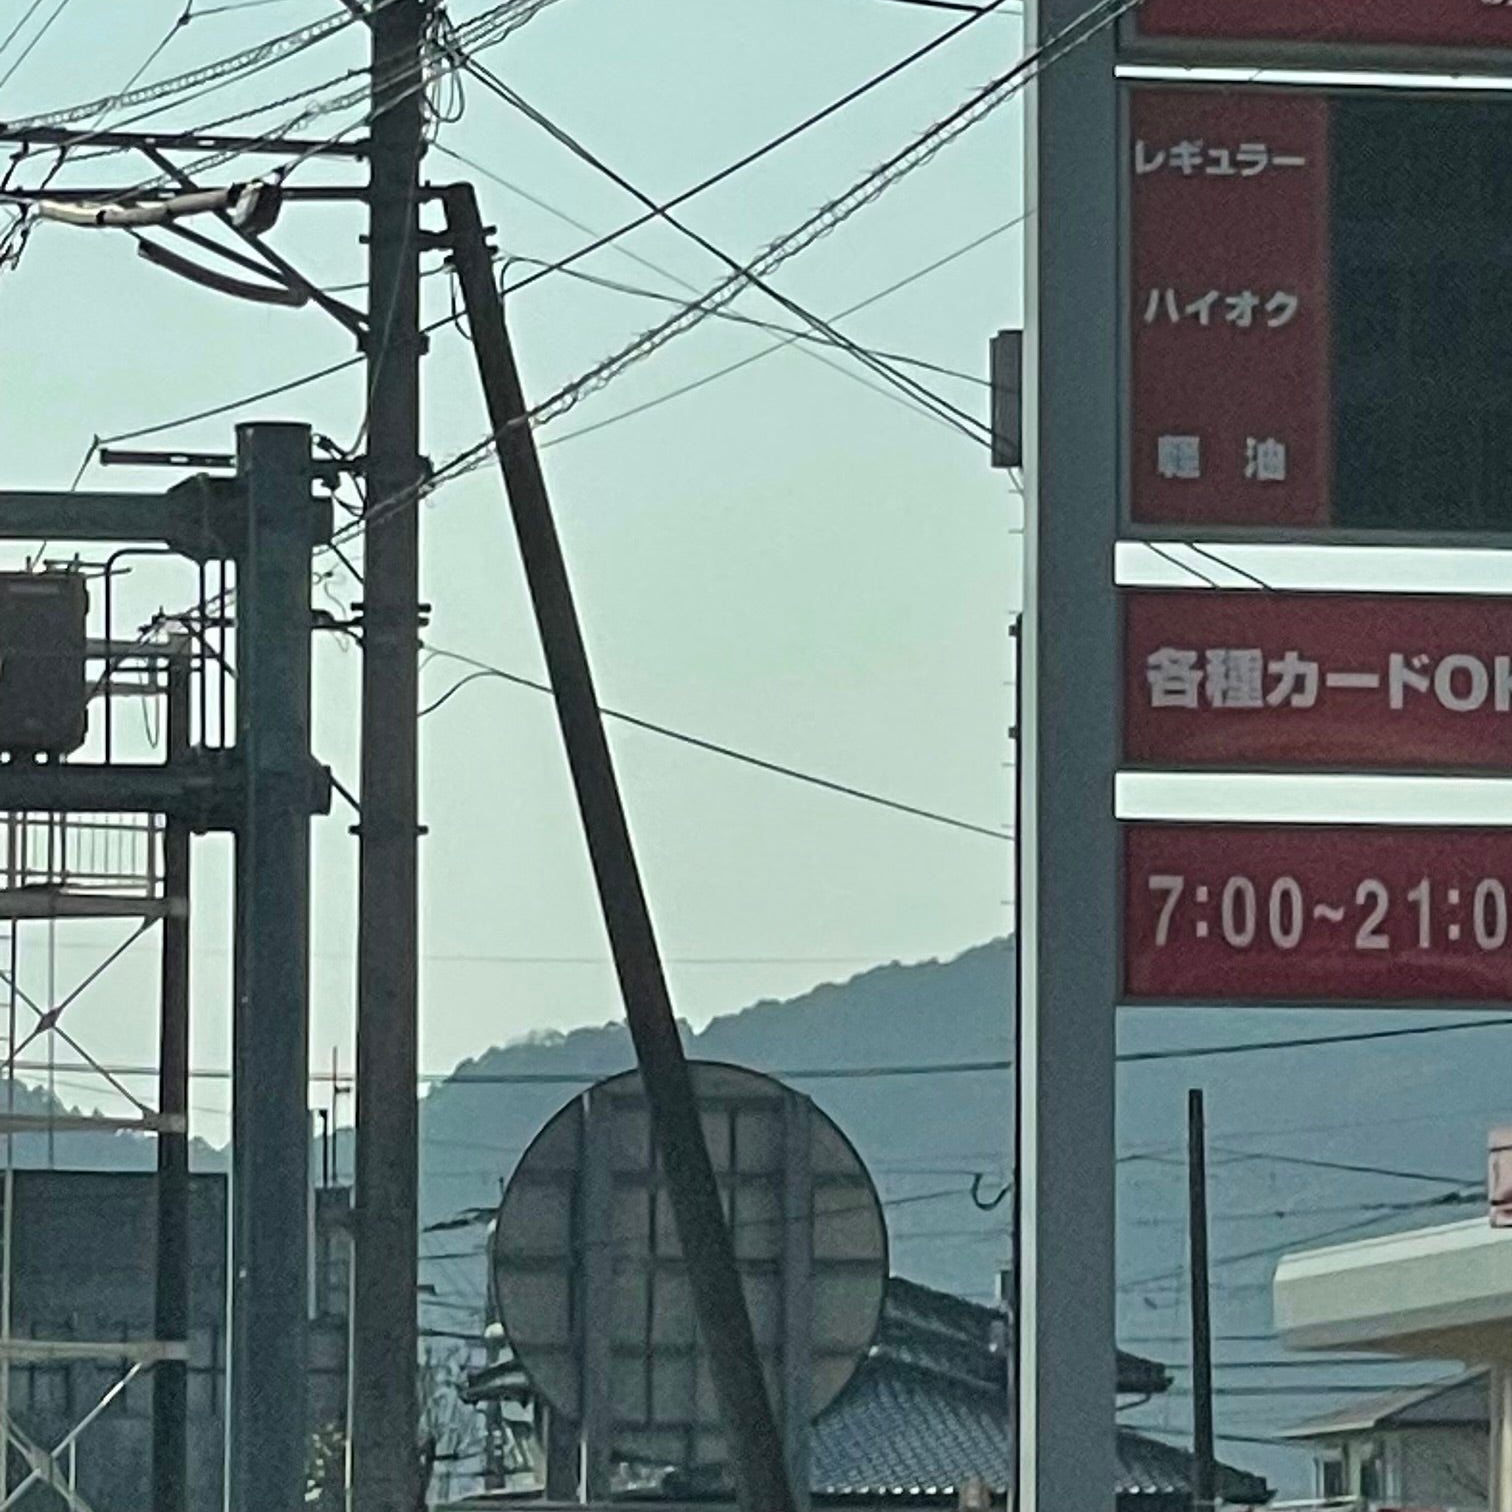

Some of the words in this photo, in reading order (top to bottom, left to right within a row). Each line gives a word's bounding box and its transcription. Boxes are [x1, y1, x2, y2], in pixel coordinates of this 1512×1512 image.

[1134, 138, 1306, 177] レギュラー
[1143, 288, 1299, 328] ハイオク
